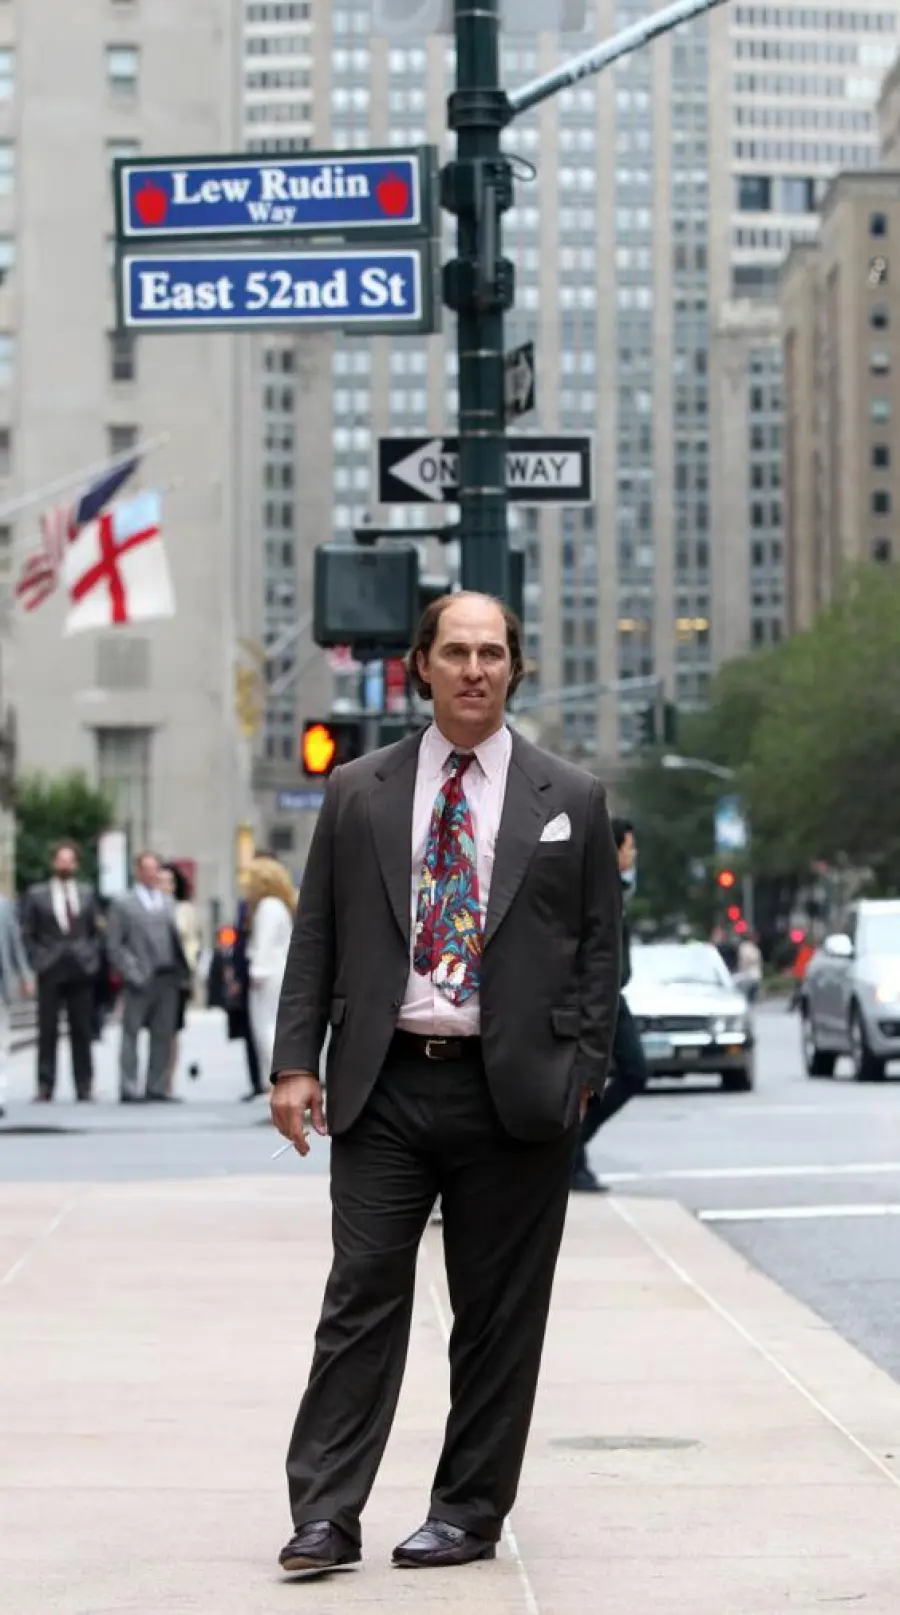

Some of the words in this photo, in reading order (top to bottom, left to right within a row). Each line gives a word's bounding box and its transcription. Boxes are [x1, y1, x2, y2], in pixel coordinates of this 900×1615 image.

[172, 171, 251, 205] Lew
[260, 165, 369, 201] Rudin
[246, 201, 297, 225] Way
[138, 271, 235, 311] East
[245, 268, 349, 310] 52nd
[360, 267, 407, 308] St
[418, 456, 459, 483] ON
[507, 456, 568, 482] WAY
